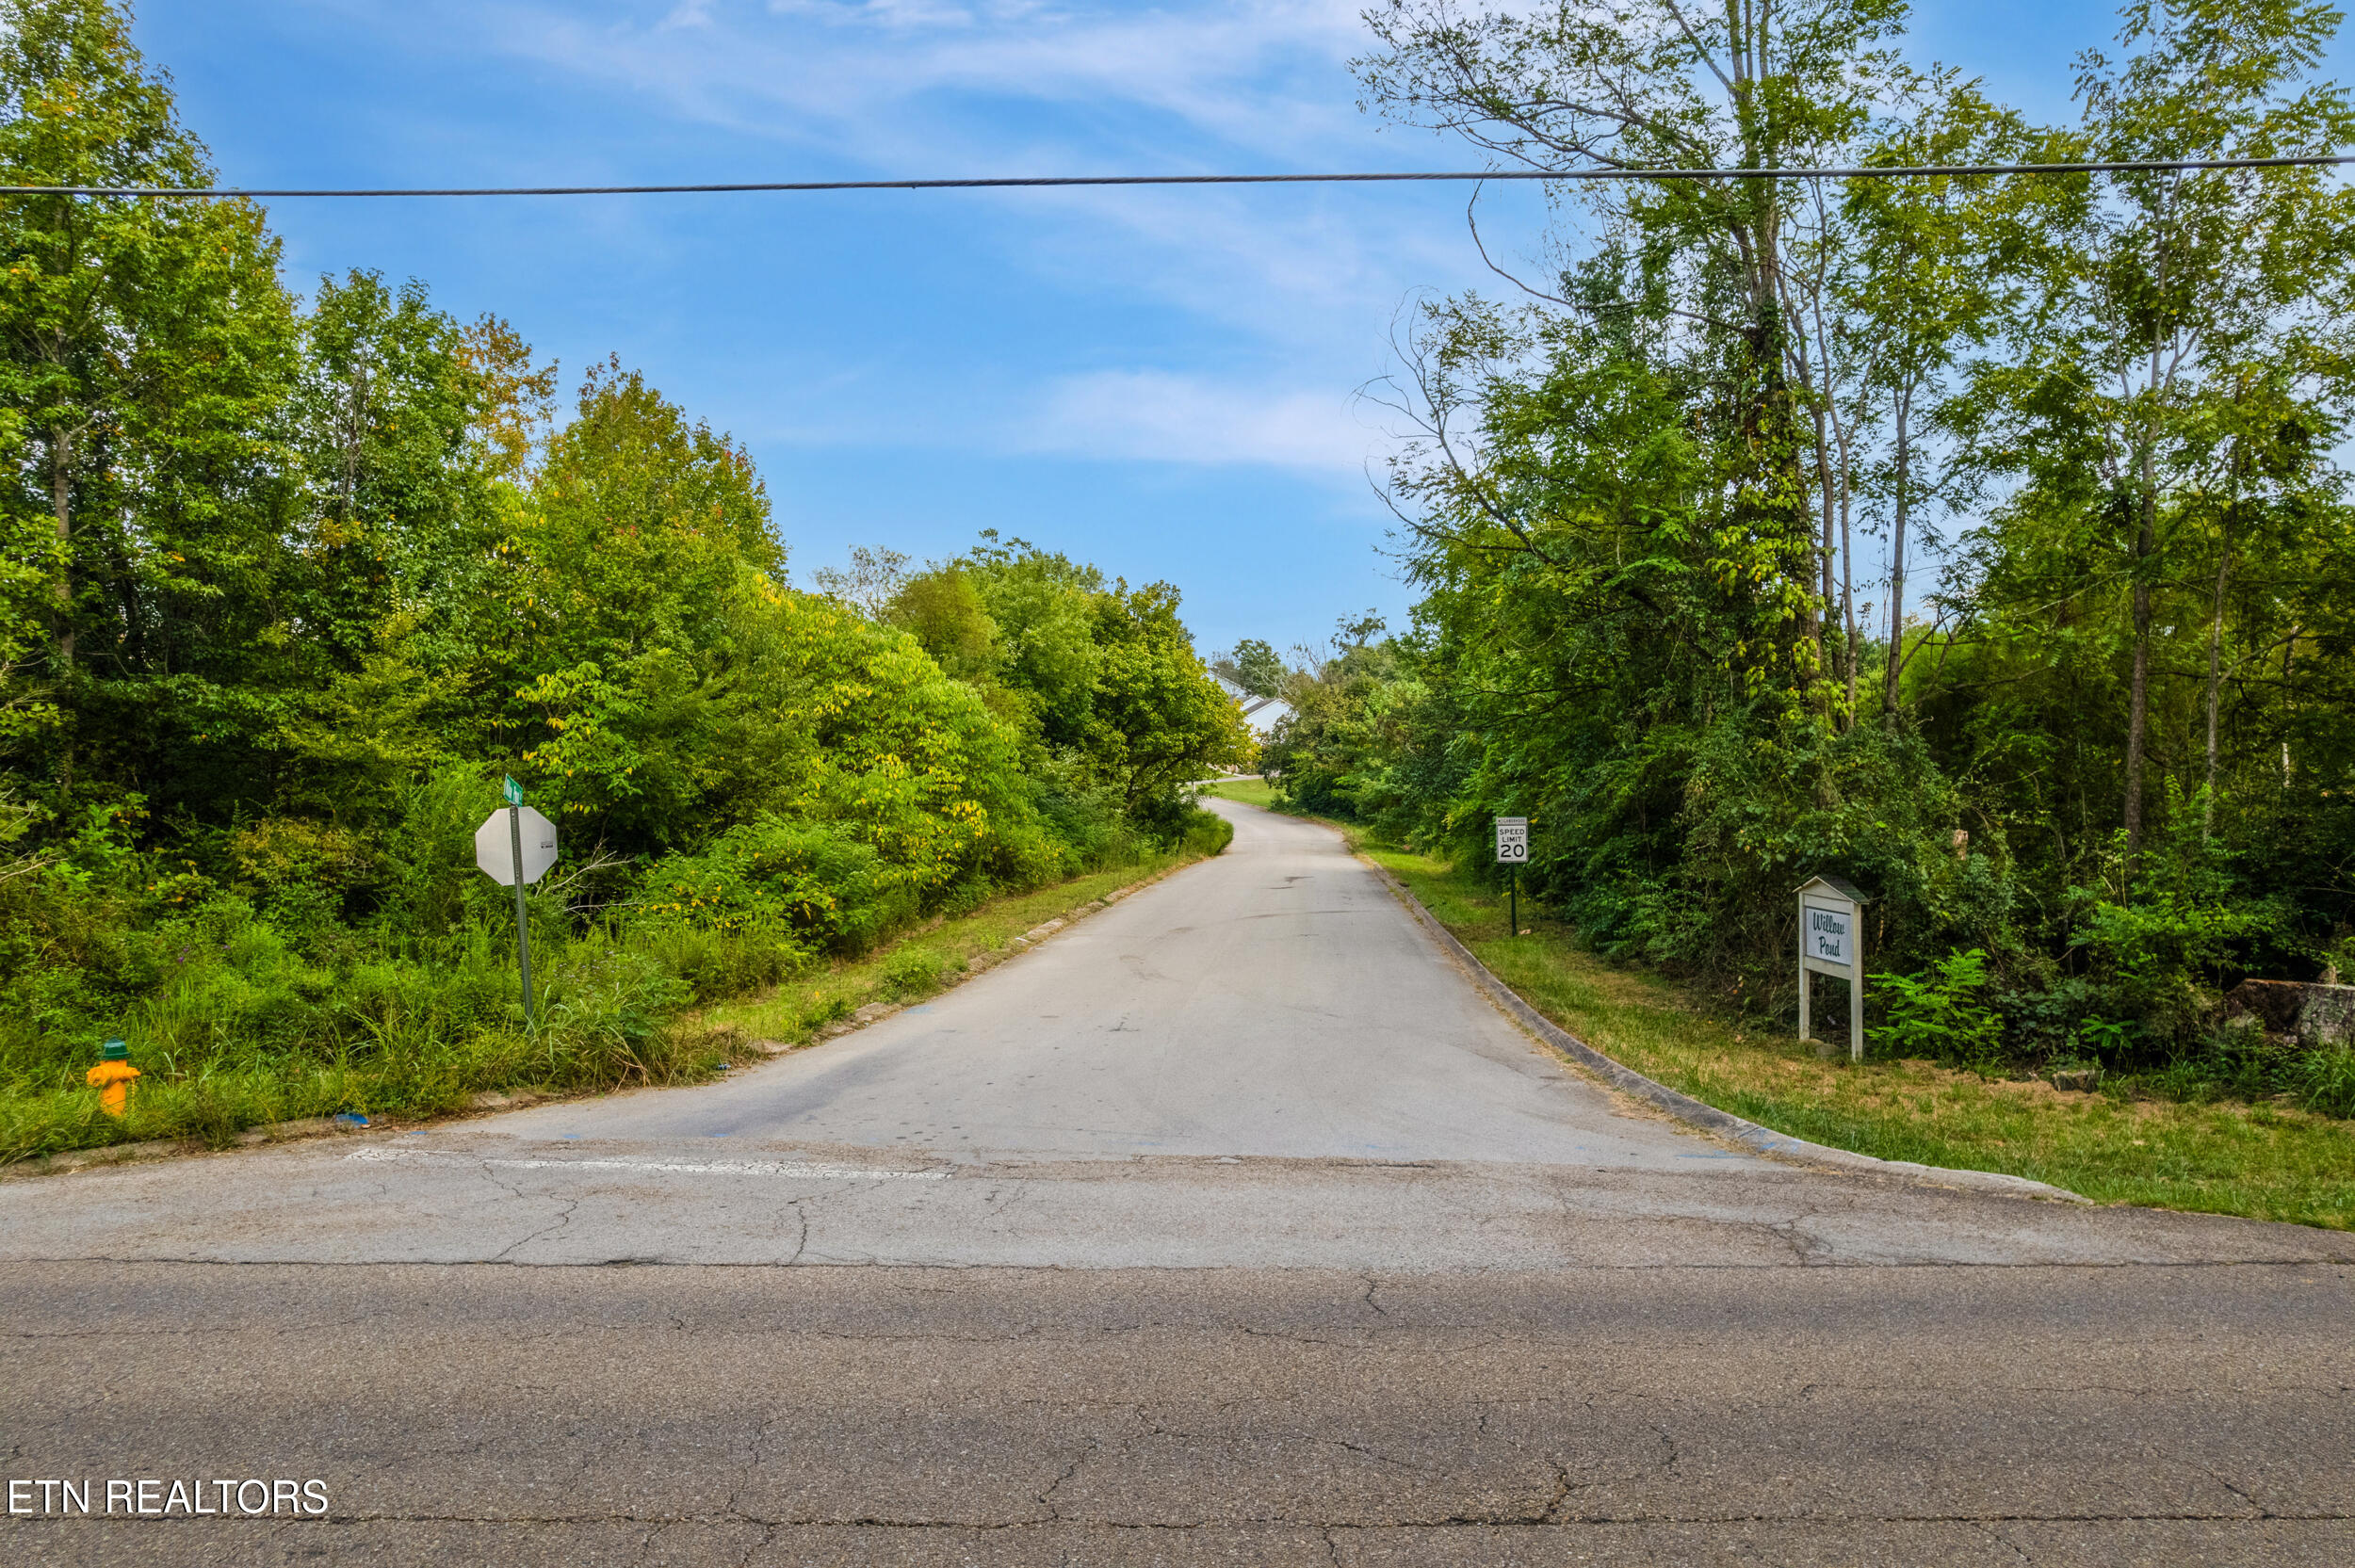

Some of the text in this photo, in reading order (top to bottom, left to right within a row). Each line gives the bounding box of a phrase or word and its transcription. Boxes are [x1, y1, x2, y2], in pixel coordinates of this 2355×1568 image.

[1501, 844, 1524, 858] 20
[1812, 912, 1845, 935] Willow
[1818, 936, 1841, 958] Pond
